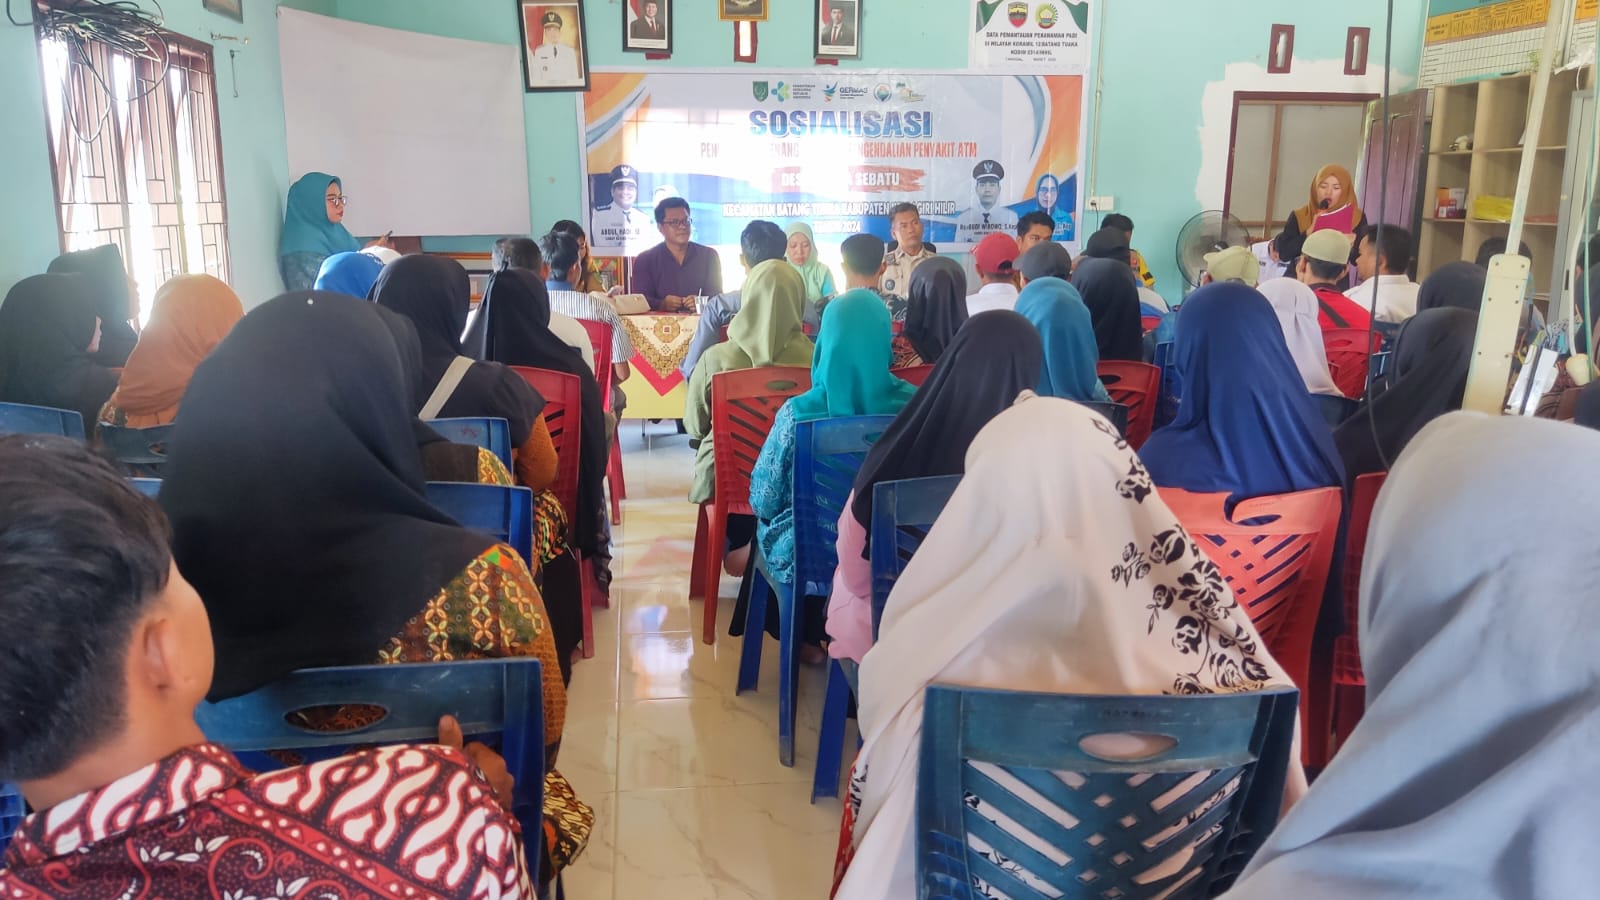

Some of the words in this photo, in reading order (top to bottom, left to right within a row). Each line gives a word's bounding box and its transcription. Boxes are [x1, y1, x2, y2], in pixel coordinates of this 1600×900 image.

[749, 109, 933, 138] SOSIALISASI
[913, 142, 955, 158] PENYAKIT
[958, 142, 977, 158] ATM
[856, 172, 899, 186] SEBATU
[841, 201, 890, 216] KABUPATEN
[934, 201, 956, 216] HILIR
